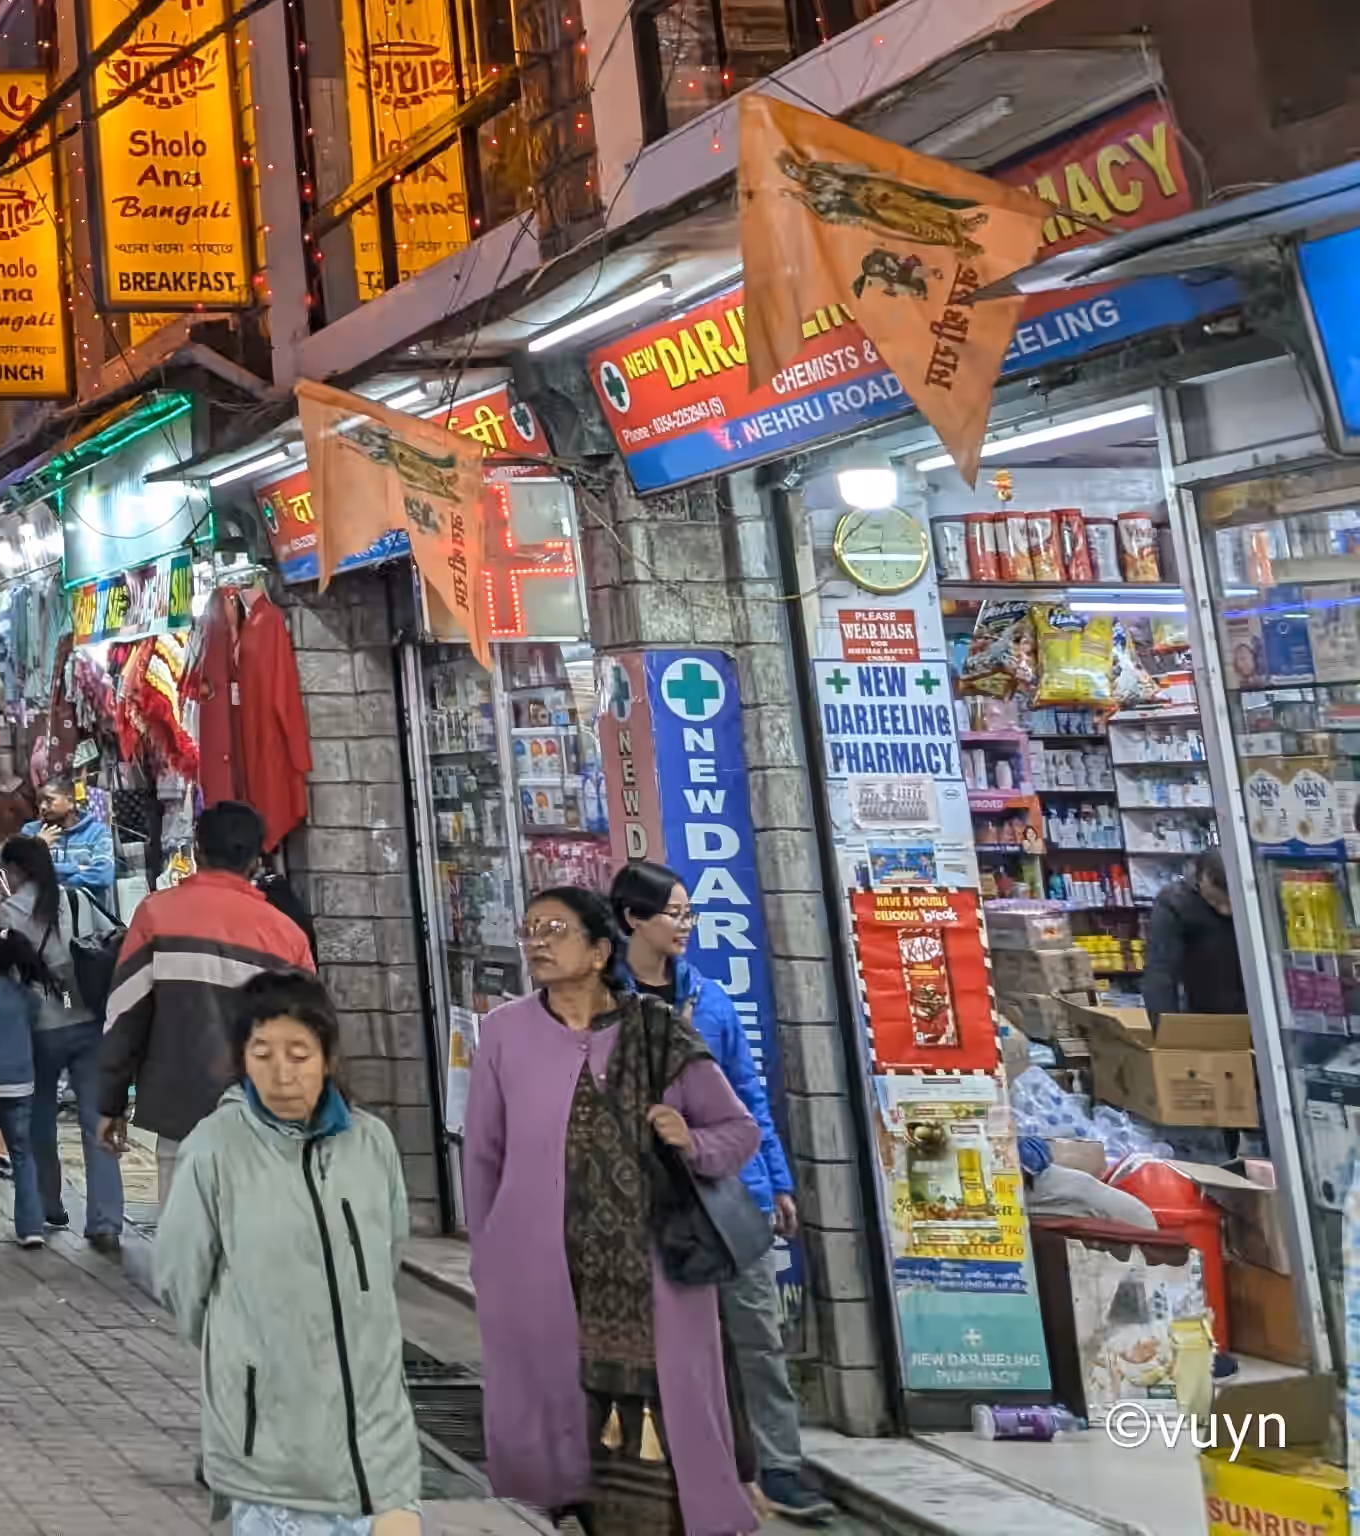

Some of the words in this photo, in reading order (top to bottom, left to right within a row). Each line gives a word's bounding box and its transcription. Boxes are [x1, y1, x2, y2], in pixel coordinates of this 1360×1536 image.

[129, 130, 207, 157] Sholo
[137, 164, 201, 187] Ana
[112, 196, 232, 225] Bangali
[119, 272, 236, 293] BREAKFAST
[623, 346, 658, 380] NEW
[772, 348, 860, 394] CHEMISTS
[863, 339, 879, 364] &
[743, 402, 824, 443] NEHRU
[830, 375, 903, 415] ROAD
[855, 612, 896, 621] PLEASE
[842, 623, 879, 639] WEAR
[880, 623, 914, 639] MASK
[857, 666, 907, 697] NEW
[823, 703, 952, 735] DARJEELING
[683, 728, 726, 814] NEW
[830, 742, 955, 774] PHARMACY
[1250, 782, 1280, 799] NAN
[1294, 782, 1326, 799] NAN
[876, 896, 902, 907] HAVE
[903, 896, 910, 906] A
[922, 908, 958, 923] break
